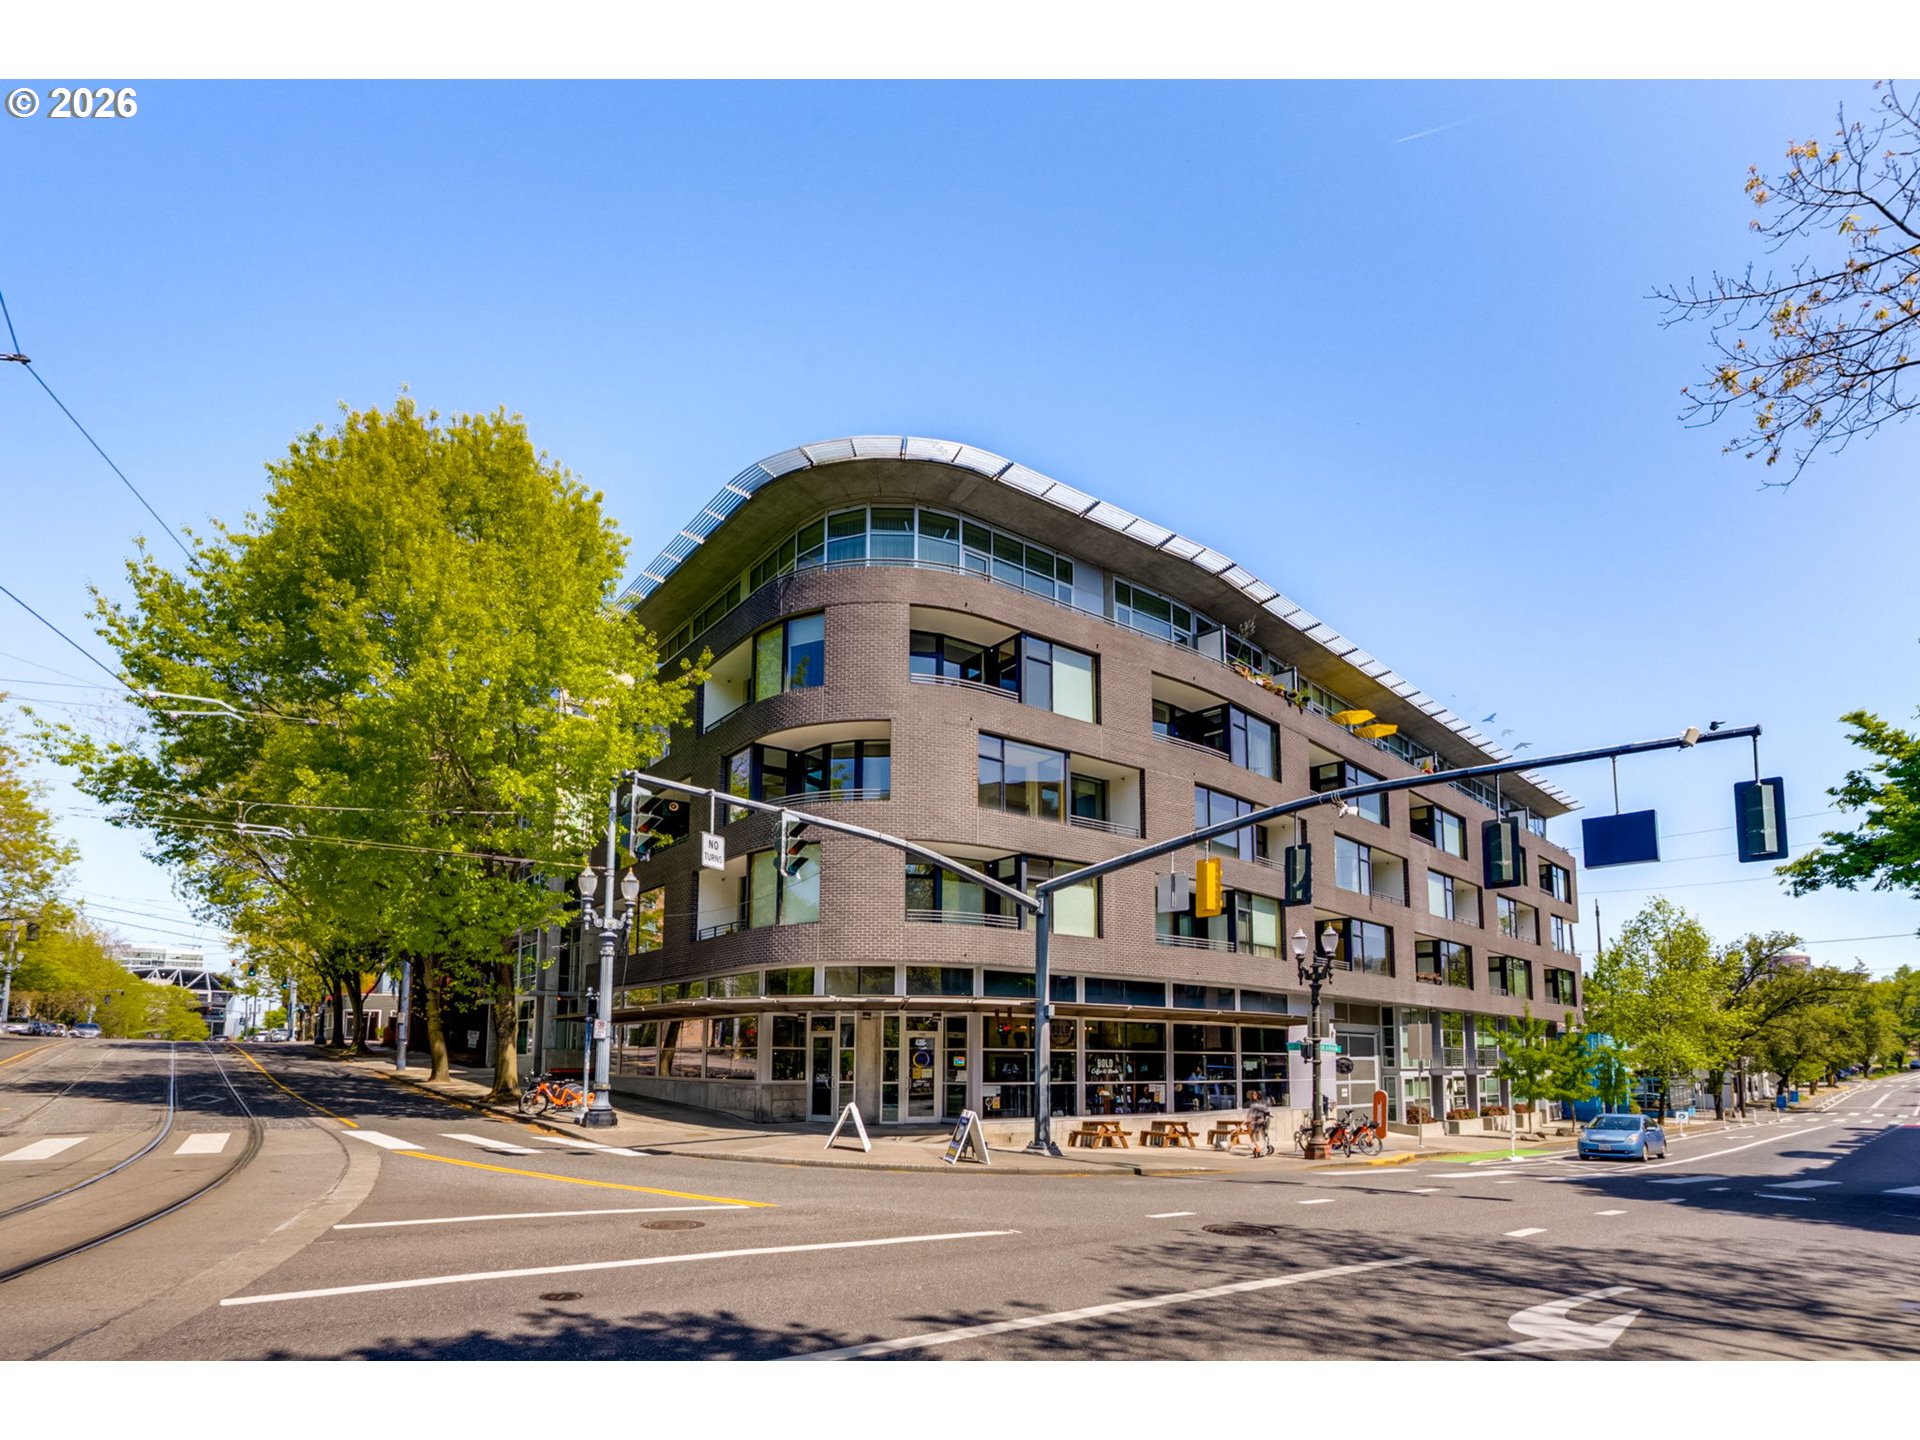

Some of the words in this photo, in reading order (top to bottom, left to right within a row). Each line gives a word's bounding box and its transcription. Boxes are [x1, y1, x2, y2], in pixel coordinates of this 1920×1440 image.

[708, 839, 719, 850] NO
[704, 851, 723, 864] TURNS
[1051, 1025, 1070, 1034] BOLD
[1097, 1058, 1114, 1068] BOLD
